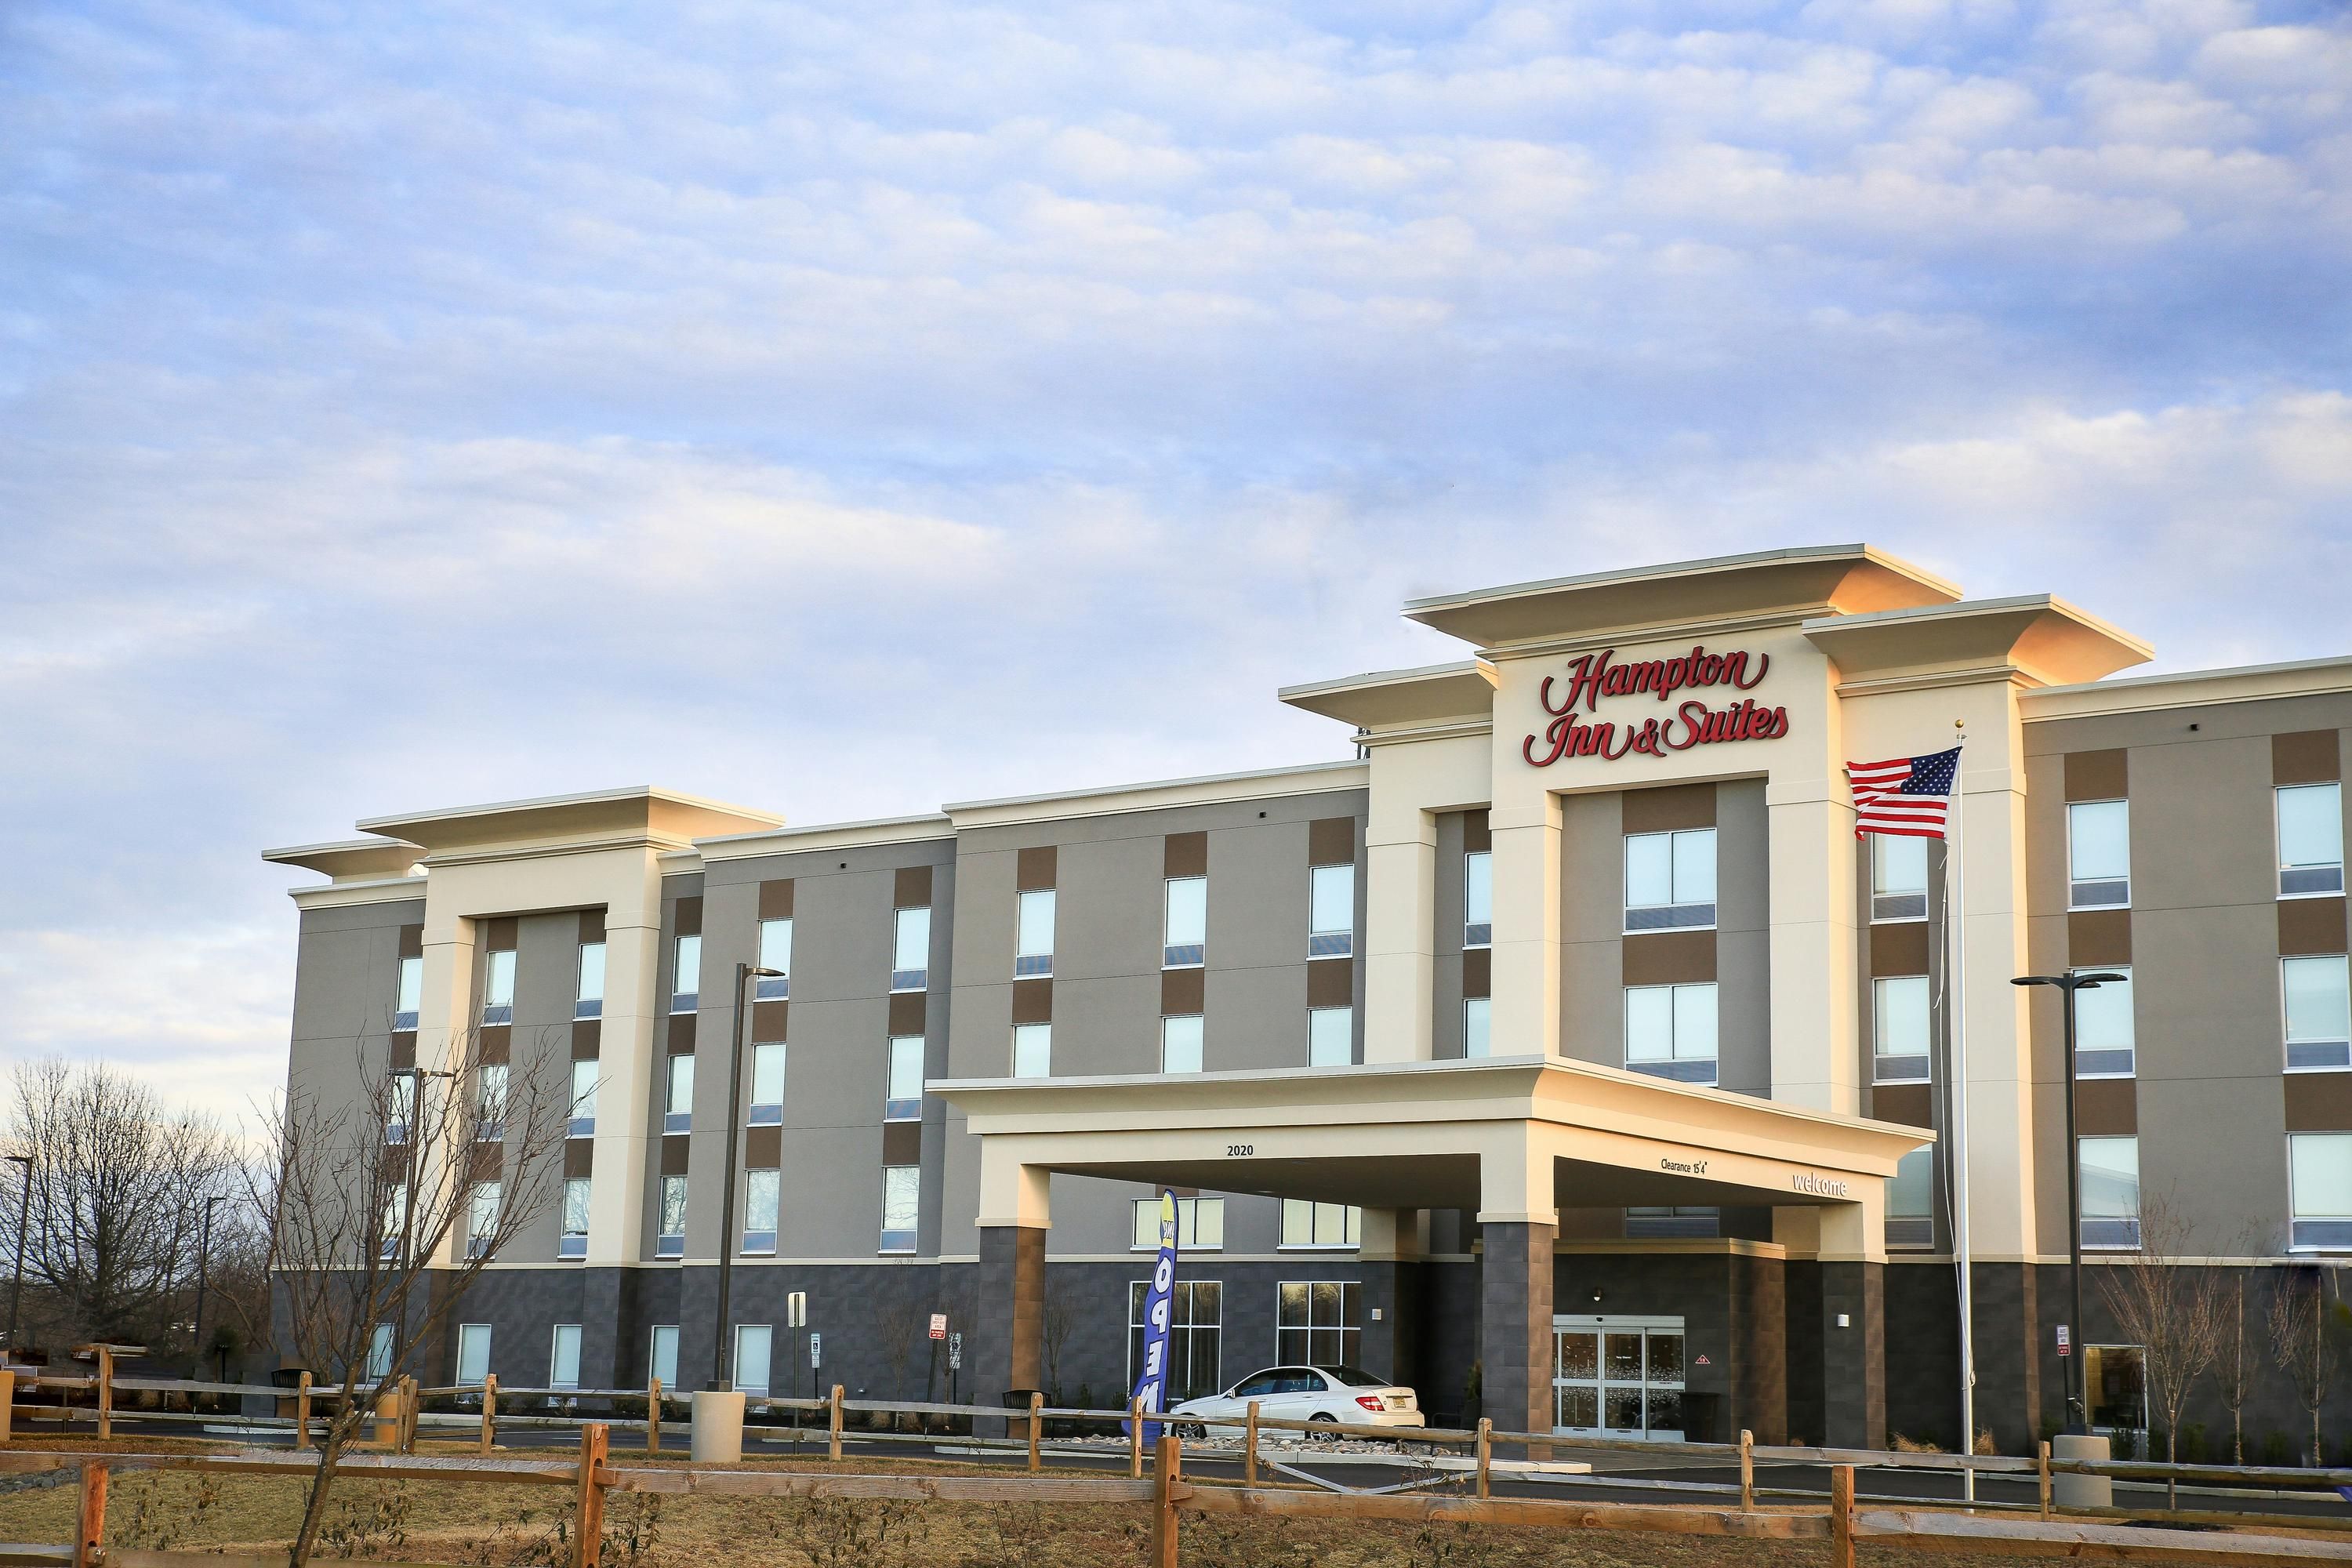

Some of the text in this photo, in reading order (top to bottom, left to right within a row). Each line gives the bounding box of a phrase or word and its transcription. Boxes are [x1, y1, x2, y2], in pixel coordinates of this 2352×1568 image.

[1541, 645, 1769, 716] Hampton
[1523, 698, 1789, 768] Inn & Suites
[1227, 1145, 1254, 1156] 2020
[1661, 1158, 1691, 1174] Clearance
[1792, 1171, 1847, 1196] welcome
